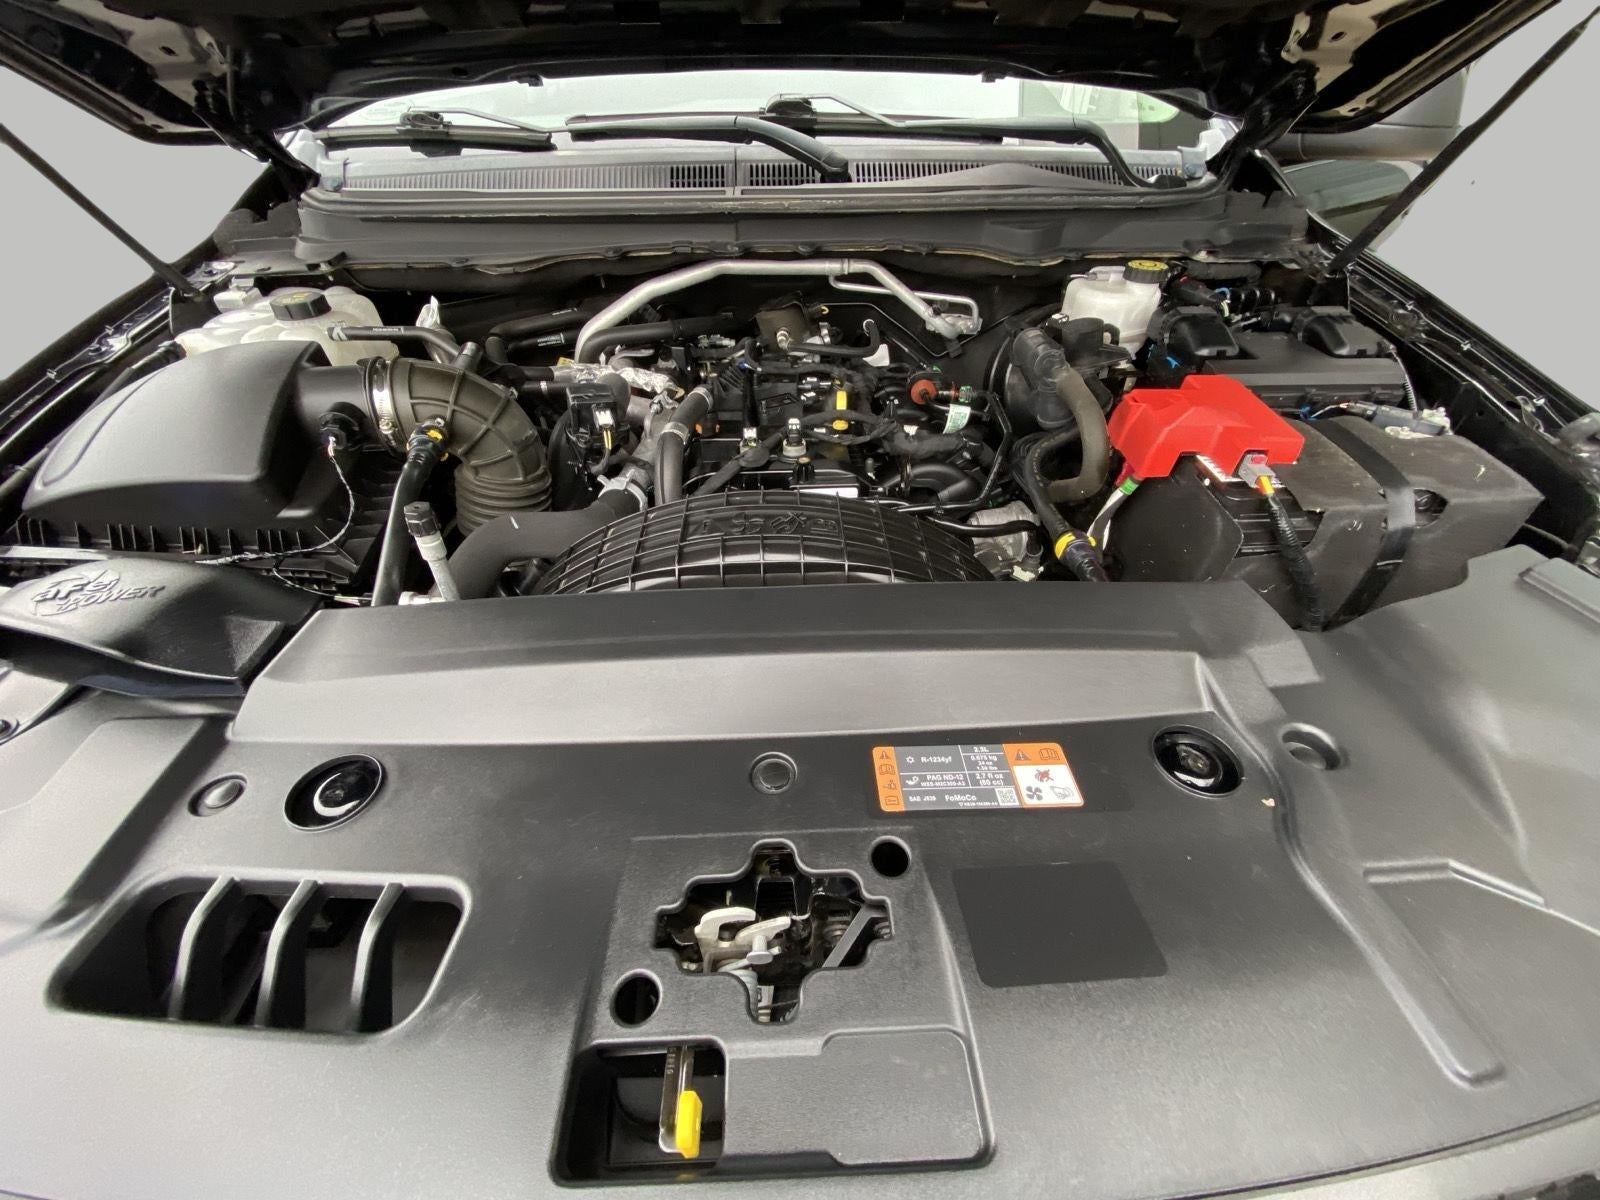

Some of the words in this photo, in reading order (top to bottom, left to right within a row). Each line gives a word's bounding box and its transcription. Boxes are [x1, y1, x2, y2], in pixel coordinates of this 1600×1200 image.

[56, 585, 166, 612] POWER
[920, 755, 952, 764] R-1234yf
[943, 773, 964, 781] ND-12
[945, 794, 977, 802] FoMoCo
